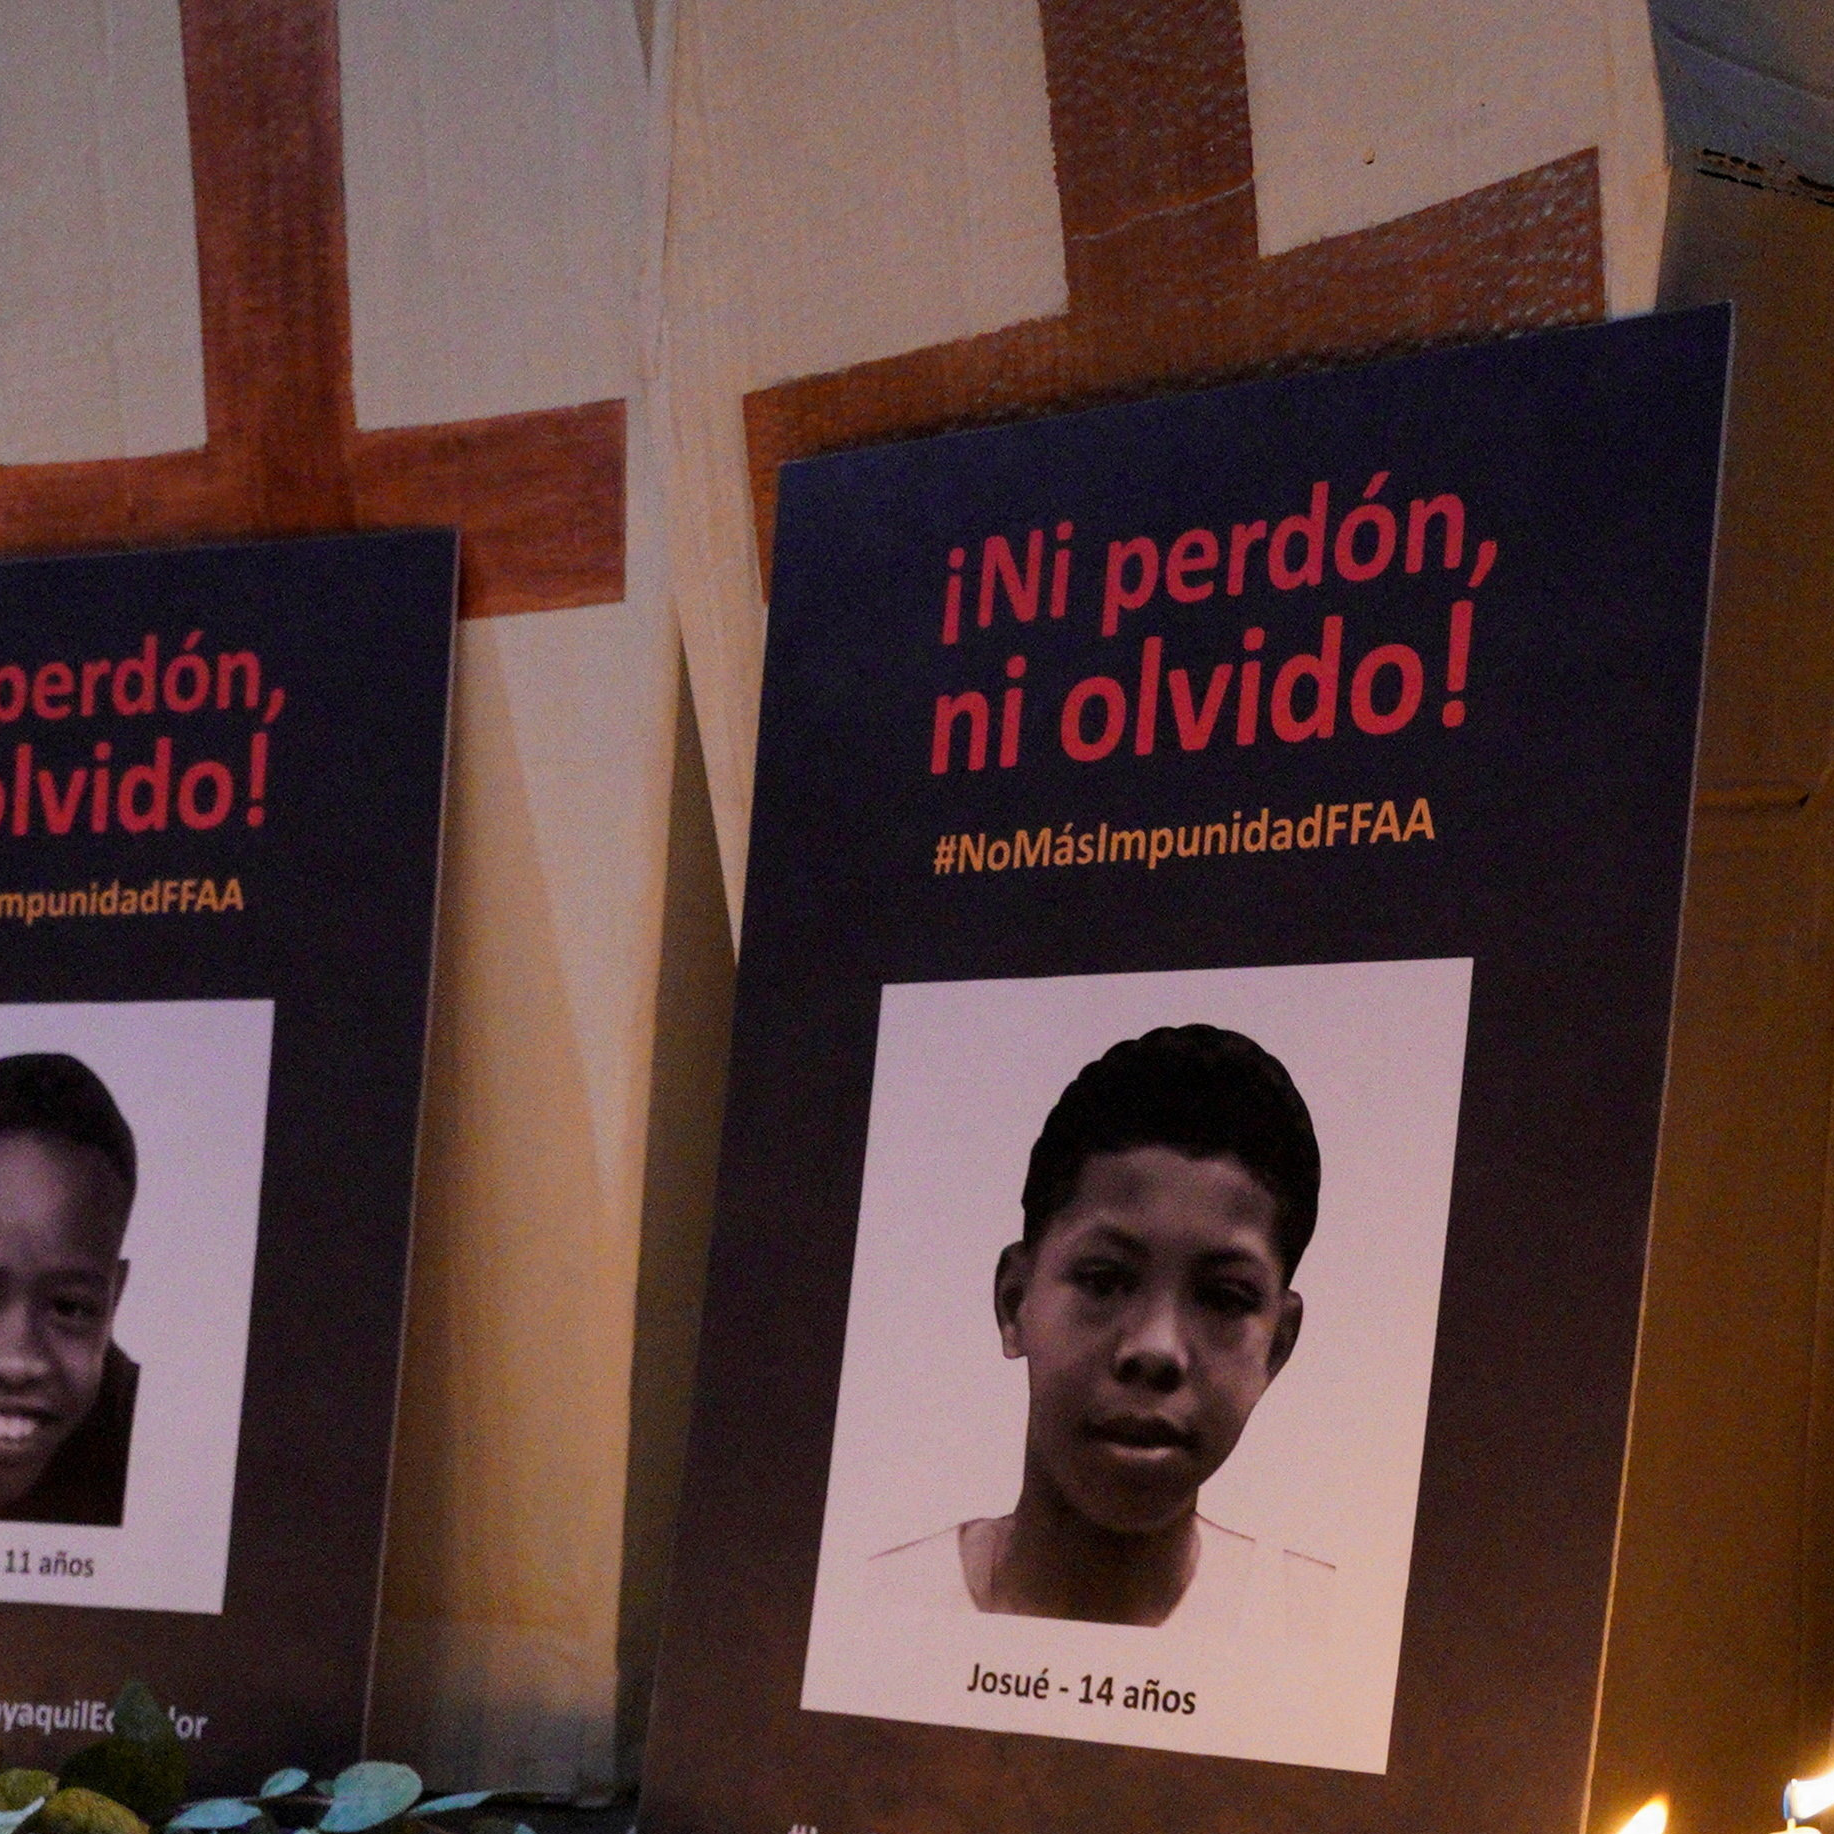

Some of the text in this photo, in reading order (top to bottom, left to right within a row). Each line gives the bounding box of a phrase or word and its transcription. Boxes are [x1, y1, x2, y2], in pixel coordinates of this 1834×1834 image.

[941, 470, 1499, 646] ¡Ni perdón,
[930, 599, 1474, 775] ni olvido!
[933, 797, 1435, 872] #NoMásImpunidadFFAA
[4, 1550, 31, 1574] 11
[38, 1552, 94, 1577] años
[967, 1662, 1050, 1700] Josué
[1078, 1674, 1114, 1708] 14
[1123, 1679, 1196, 1716] años
